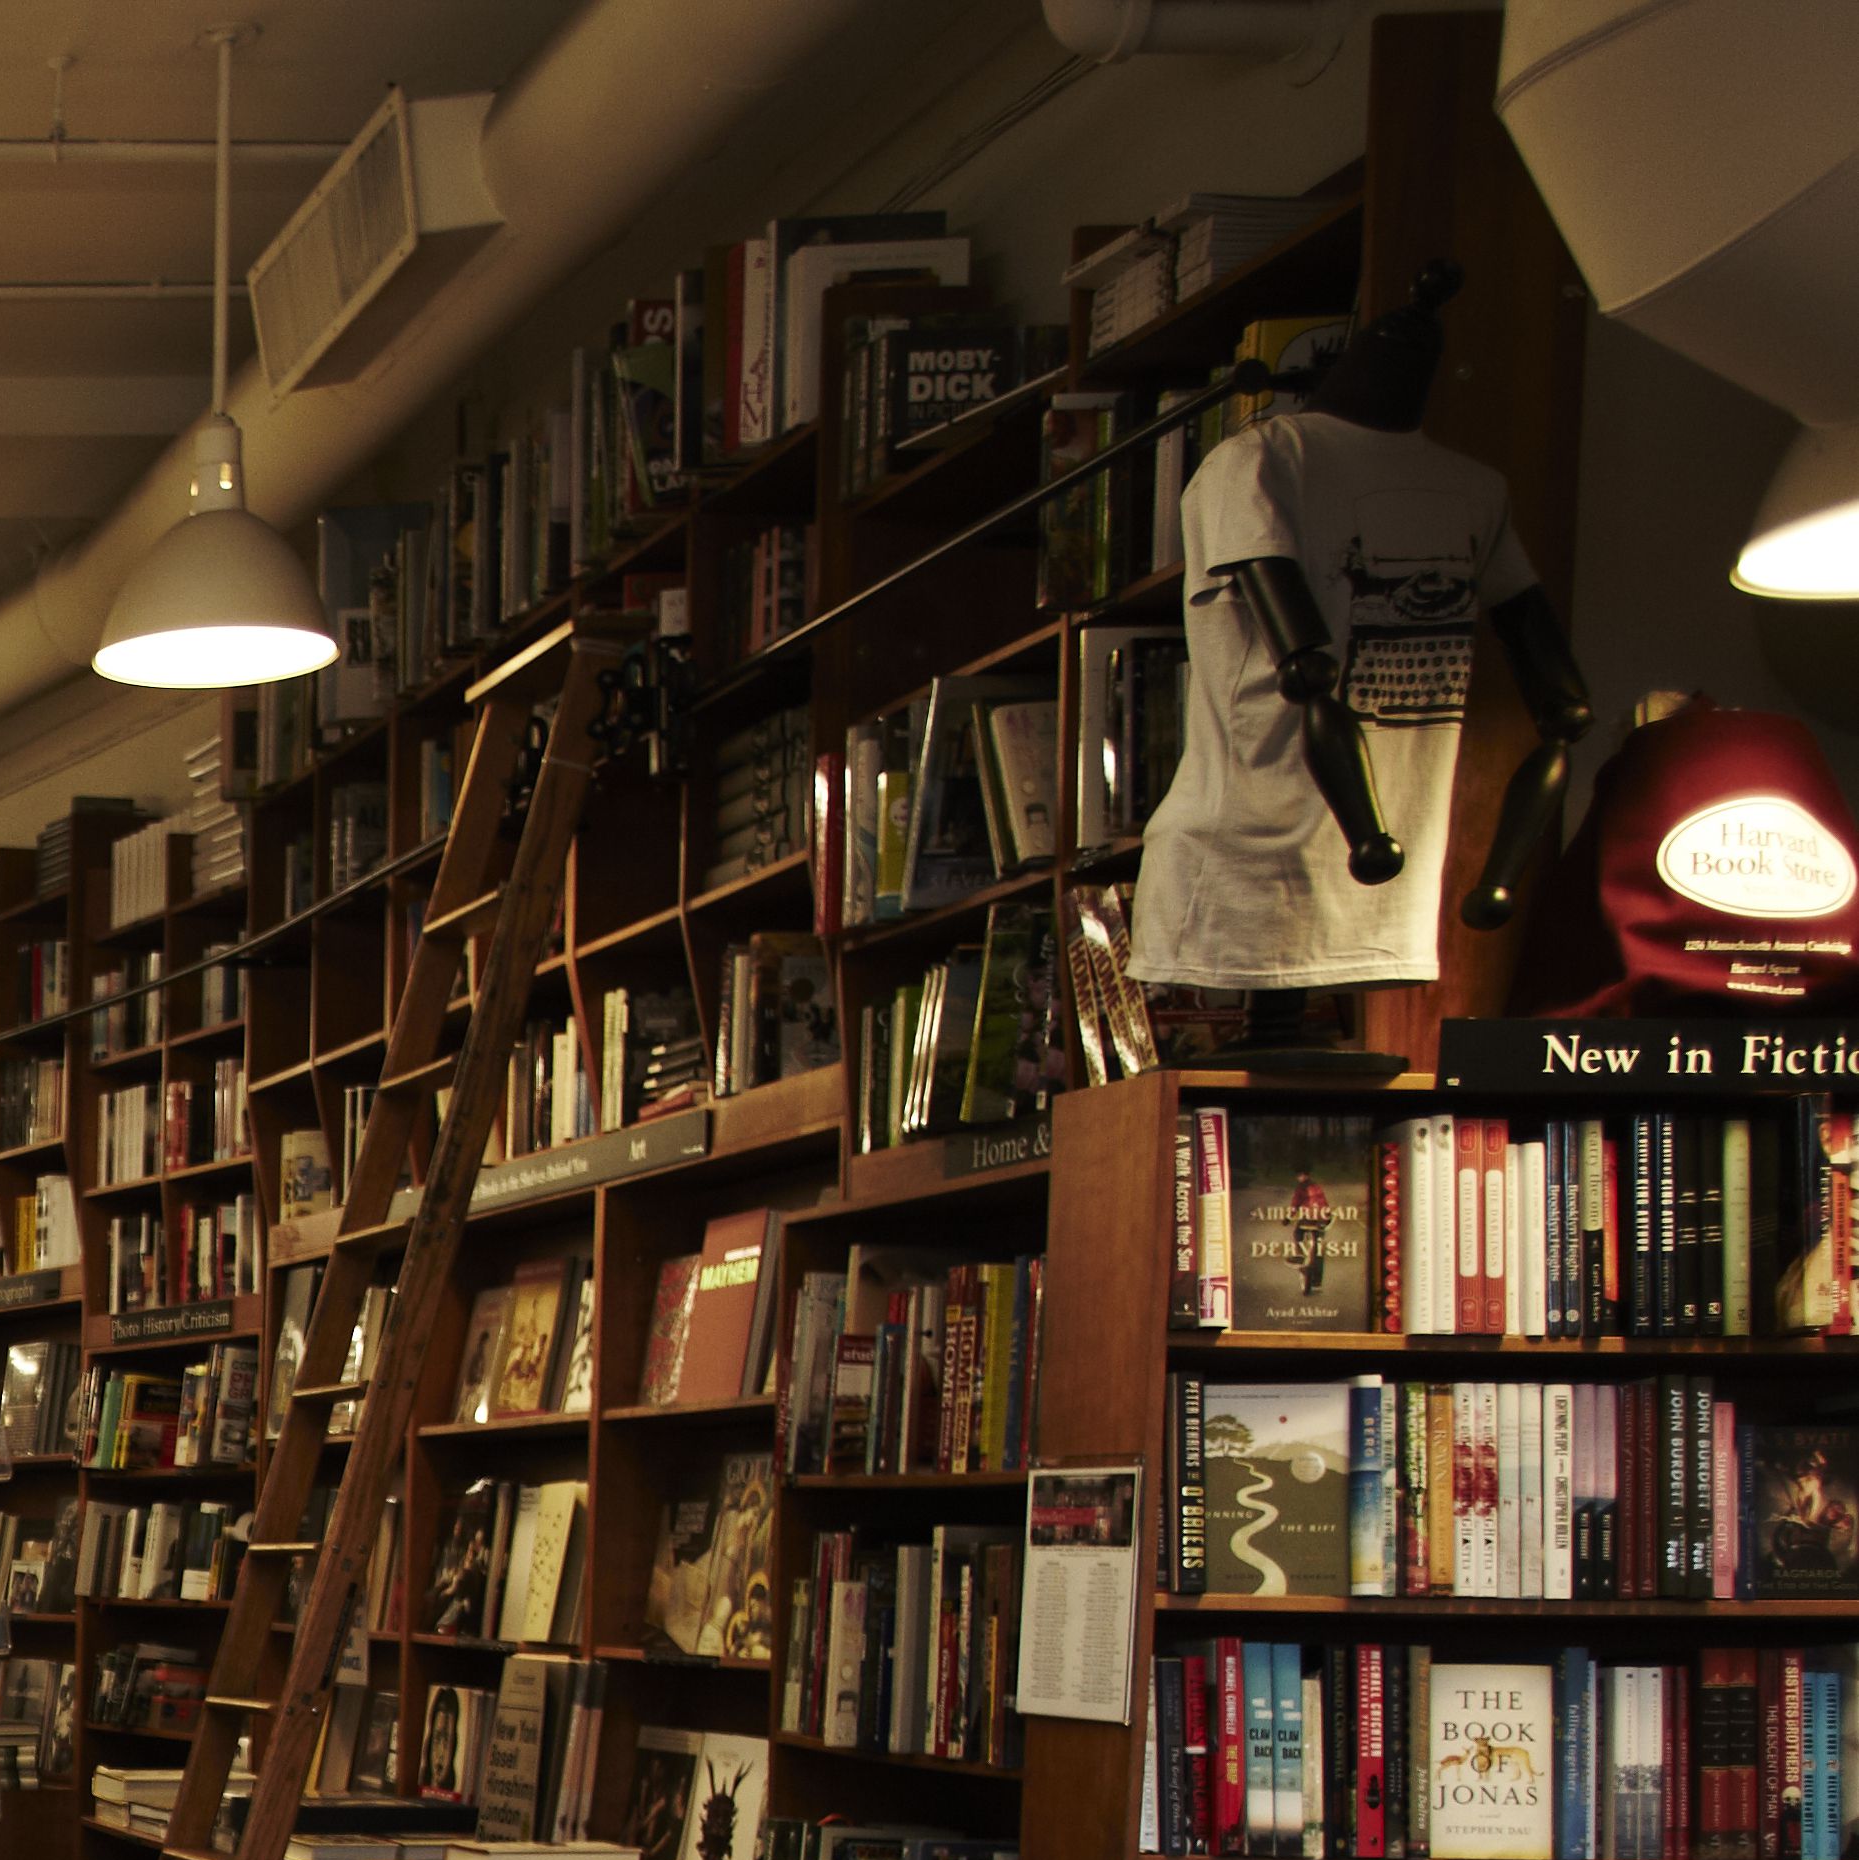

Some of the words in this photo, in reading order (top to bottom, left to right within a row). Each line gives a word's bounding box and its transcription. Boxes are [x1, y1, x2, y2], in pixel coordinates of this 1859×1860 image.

[908, 349, 999, 373] MOBY-
[907, 371, 996, 402] DICK
[1721, 823, 1819, 857] Harvard
[1690, 851, 1774, 876] Book
[1784, 855, 1836, 887] Store
[1542, 1034, 1639, 1073] New
[1668, 1035, 1713, 1073] in
[972, 1136, 1028, 1168] Home
[1032, 1122, 1049, 1156] &
[1250, 1205, 1359, 1222] AMERICAN
[1251, 1239, 1358, 1259] DERVISH
[1456, 1689, 1524, 1710] THE
[1443, 1722, 1536, 1742] BOOK
[1472, 1752, 1512, 1773] OF
[1435, 1784, 1539, 1806] JONAS
